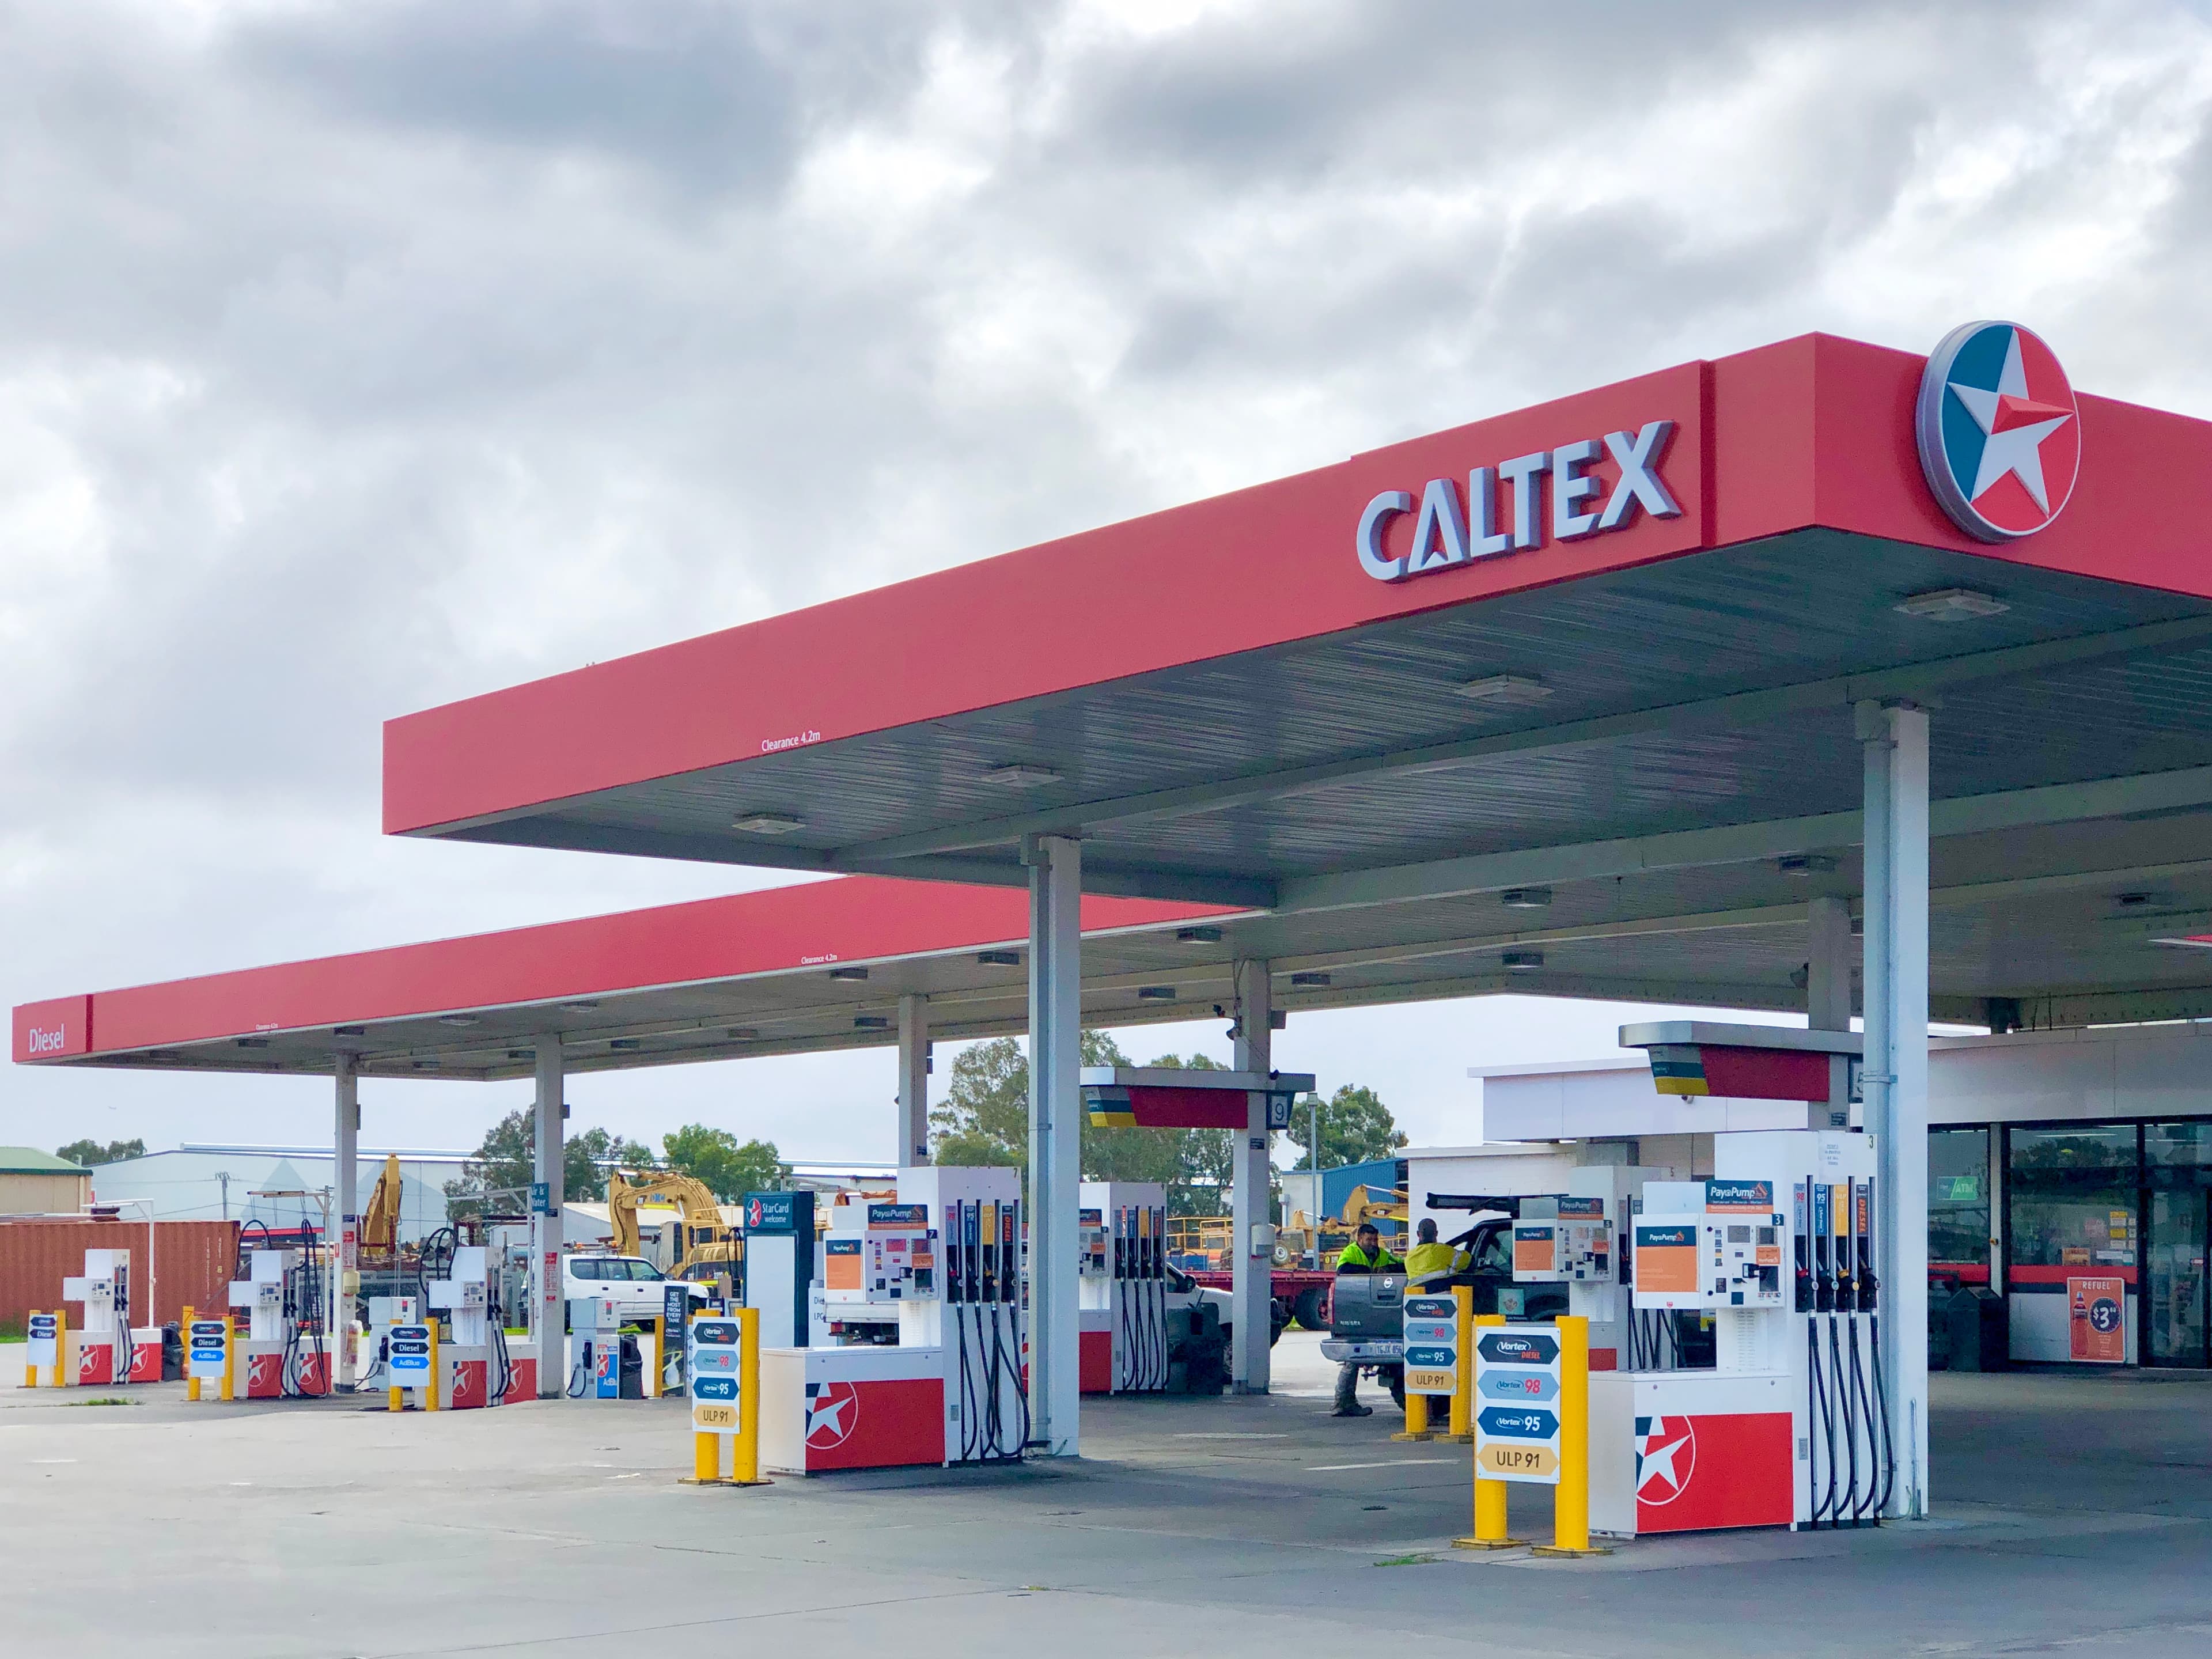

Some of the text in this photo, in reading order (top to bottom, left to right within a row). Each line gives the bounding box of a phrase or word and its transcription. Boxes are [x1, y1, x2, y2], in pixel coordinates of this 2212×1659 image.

[1357, 420, 1681, 581] CALTEX
[762, 730, 820, 752] Clearance 4.2m
[801, 953, 838, 964] Clearance 4.2m
[29, 1023, 64, 1053] Diesel
[1275, 1103, 1284, 1121] 9
[1869, 1135, 1874, 1149] 3
[1013, 1167, 1018, 1178] 7
[539, 1186, 545, 1196] &
[1796, 1192, 1805, 1200] 98
[1817, 1194, 1825, 1202] 95
[762, 1203, 789, 1213] StarCard
[967, 1213, 974, 1221] 95
[1775, 1215, 1781, 1225] 3
[1859, 1198, 1867, 1233] DIESEL
[2082, 1281, 2110, 1290] REFUEL
[1434, 1328, 1445, 1338] 98
[1499, 1342, 1527, 1350] Vortex
[719, 1355, 729, 1366] 98
[1434, 1352, 1445, 1362] 95
[1521, 1351, 1540, 1359] DIESEL
[1416, 1375, 1444, 1385] ULP 91
[719, 1383, 729, 1395] 95
[1499, 1379, 1541, 1394] Vortex 98
[703, 1410, 728, 1422] ULP 91
[1498, 1416, 1541, 1431] Vortex 95
[1497, 1450, 1540, 1468] ULP 91
